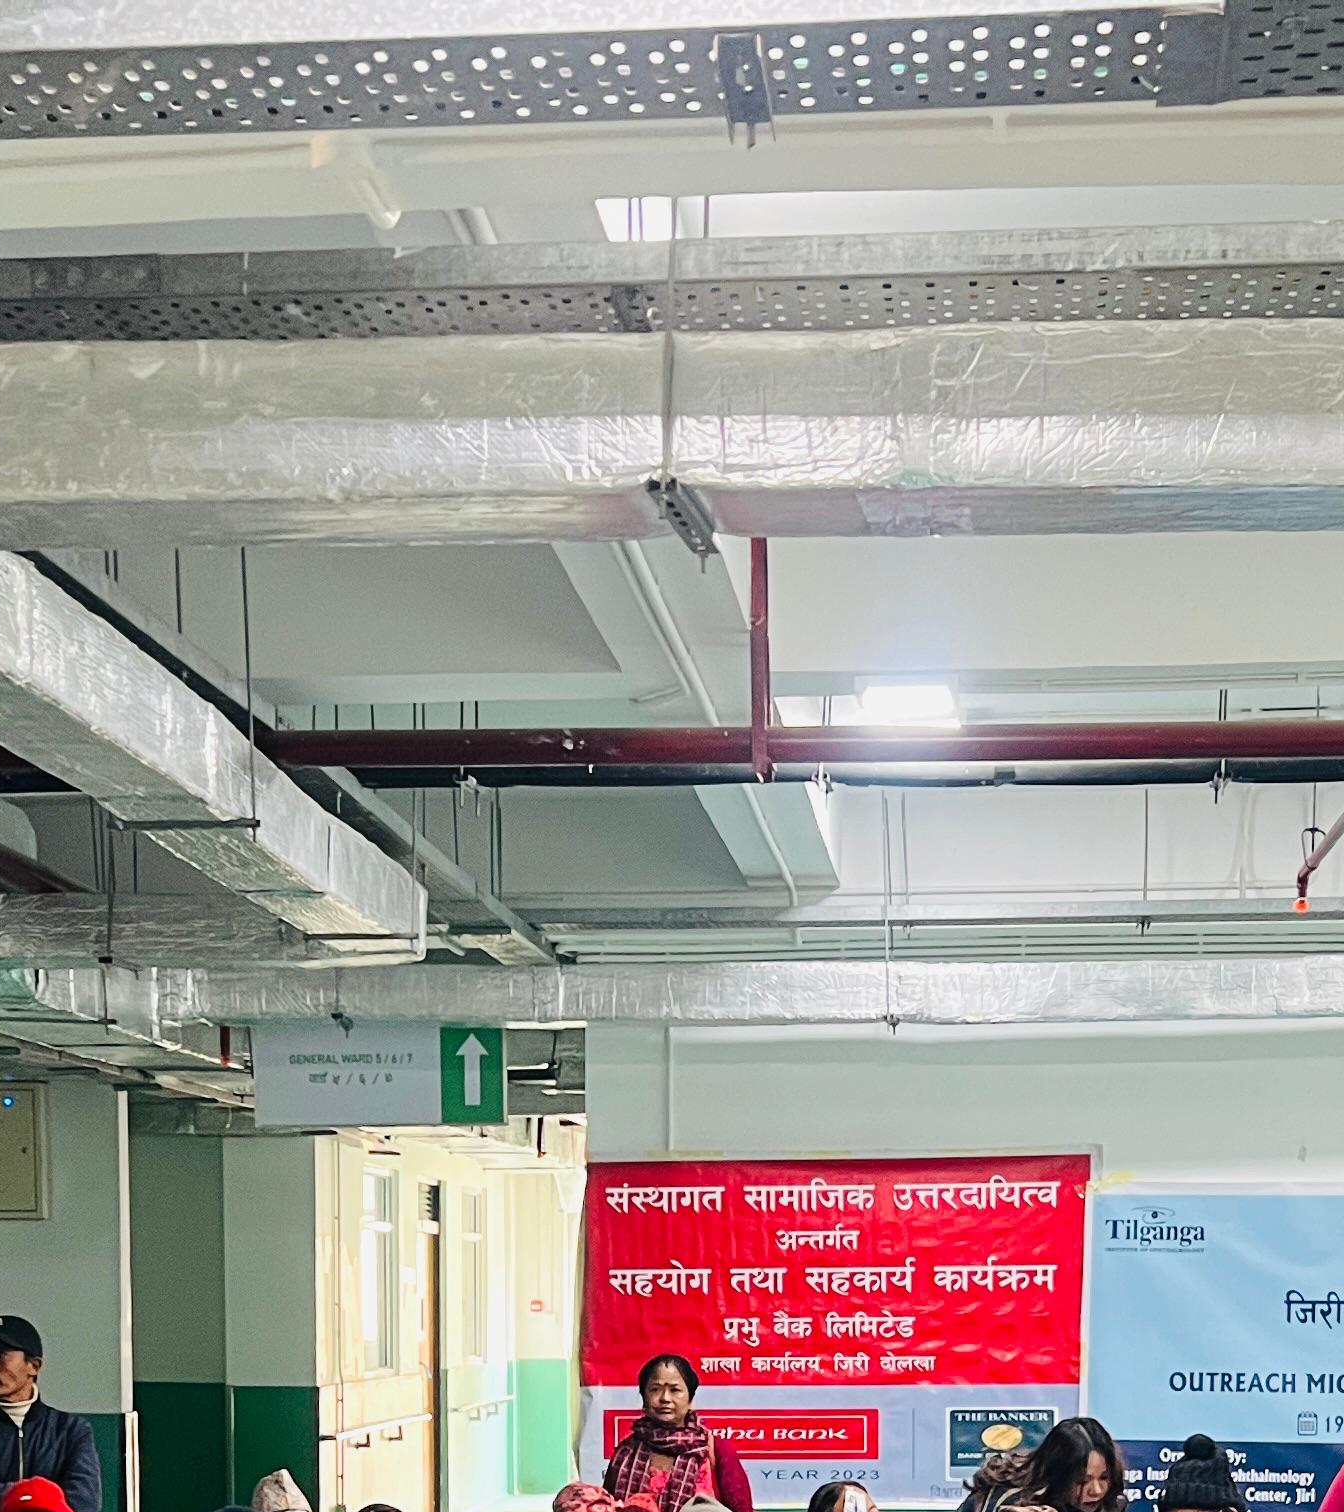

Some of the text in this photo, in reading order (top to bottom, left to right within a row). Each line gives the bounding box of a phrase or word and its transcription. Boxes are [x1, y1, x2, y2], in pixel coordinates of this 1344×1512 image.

[289, 1053, 339, 1065] GENERAL
[341, 1053, 373, 1065] WARD
[605, 1174, 1061, 1214] संस्थागत सामाजिक उत्तरदायित्व
[775, 1222, 860, 1252] अन्तर्गत
[1105, 1219, 1205, 1248] Tilganga
[608, 1255, 1058, 1298] सहयोग तथा सहकार्य कार्यक्रम
[723, 1316, 761, 1348] प्रभु
[825, 1309, 916, 1339] लिमिटेड
[700, 1356, 742, 1374] शाखा
[834, 1351, 870, 1373] जिरी
[1169, 1371, 1296, 1394] OUTREACH
[954, 1412, 1049, 1422] THE BANKER
[761, 1469, 880, 1480] YEAR 2023
[1244, 1487, 1316, 1505] Center, Jiri
